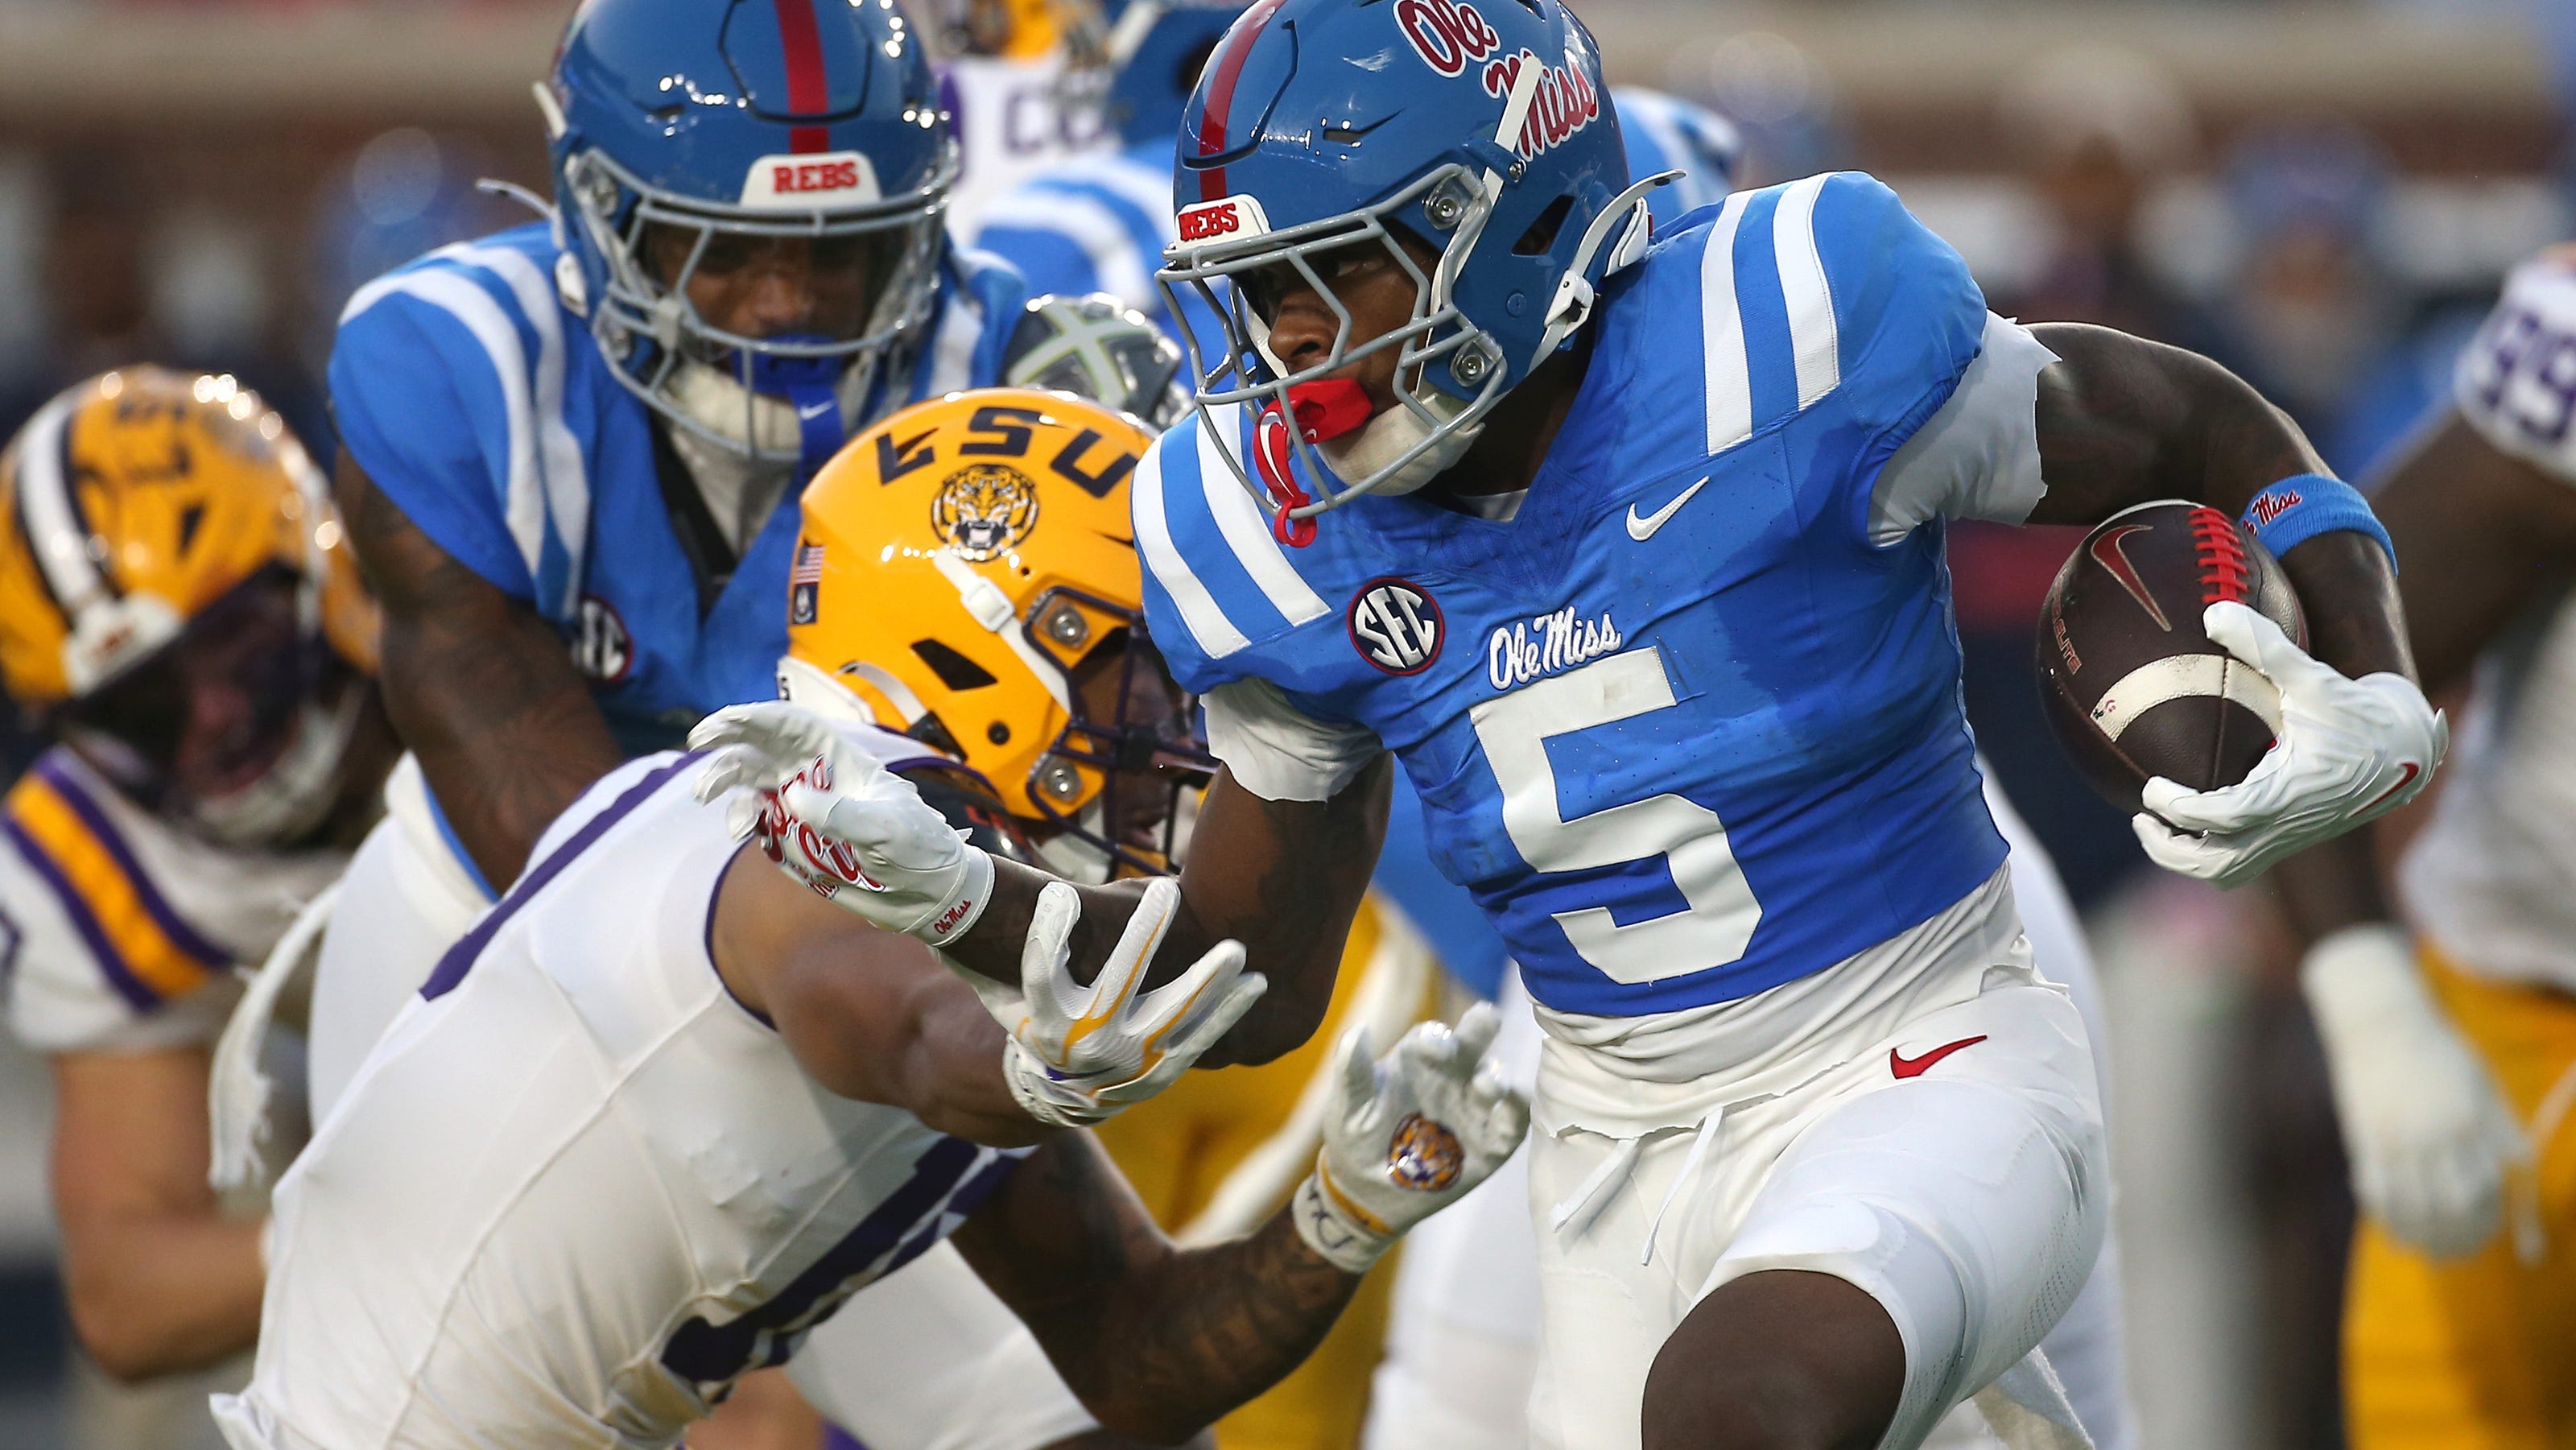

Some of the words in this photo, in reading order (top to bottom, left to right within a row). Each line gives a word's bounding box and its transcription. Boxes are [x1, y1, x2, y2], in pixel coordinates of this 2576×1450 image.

[1394, 0, 1501, 77] Ole
[1483, 48, 1599, 161] Miss
[774, 162, 858, 192] REBS
[1179, 202, 1240, 242] REBS
[875, 407, 1138, 499] LSU
[2251, 490, 2302, 527] Miss
[1355, 585, 1435, 669] SEC
[1489, 622, 1542, 690] Ole
[1533, 605, 1622, 673] Miss
[1468, 647, 1763, 985] 5
